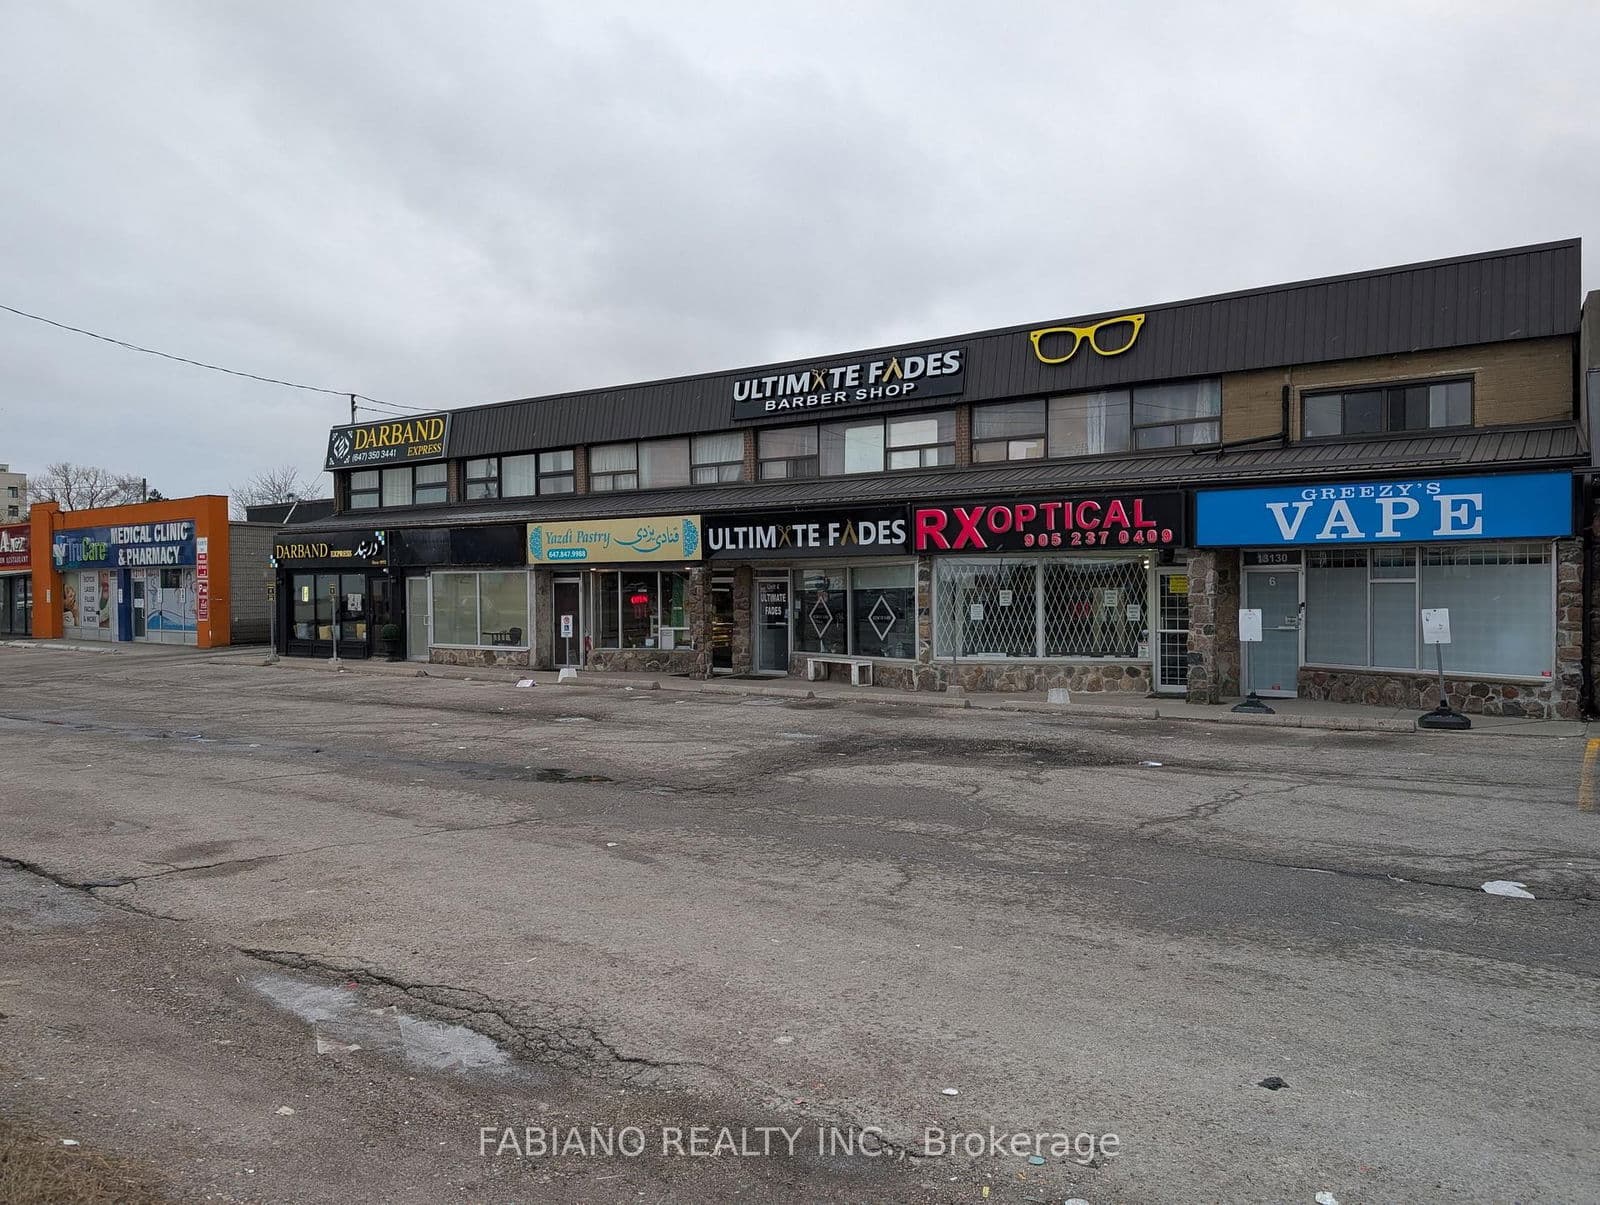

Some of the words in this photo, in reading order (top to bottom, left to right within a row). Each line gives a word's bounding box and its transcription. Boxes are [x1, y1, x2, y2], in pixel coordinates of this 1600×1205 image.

[765, 391, 847, 411] BARBER
[855, 382, 916, 401] SHOP
[354, 418, 444, 450] DARBAND
[407, 443, 442, 456] EXPRESS
[1301, 482, 1441, 501] GREEZY'S
[916, 506, 988, 550] RX
[987, 499, 1157, 534] OPTICAL
[1265, 493, 1483, 541] VAPE
[110, 525, 152, 545] MEDICAL
[154, 522, 188, 541] CLINIC
[545, 528, 573, 545] Yazdi
[576, 529, 611, 549] Pastry
[1024, 533, 1062, 548] 905
[1071, 531, 1109, 546] 237
[1118, 528, 1173, 545] 0409
[67, 536, 106, 561] TruCare
[118, 549, 126, 566] &
[127, 546, 180, 565] PHARMACY
[276, 543, 328, 559] DARBAND
[1269, 577, 1276, 586] 6
[765, 606, 782, 615] FADES
